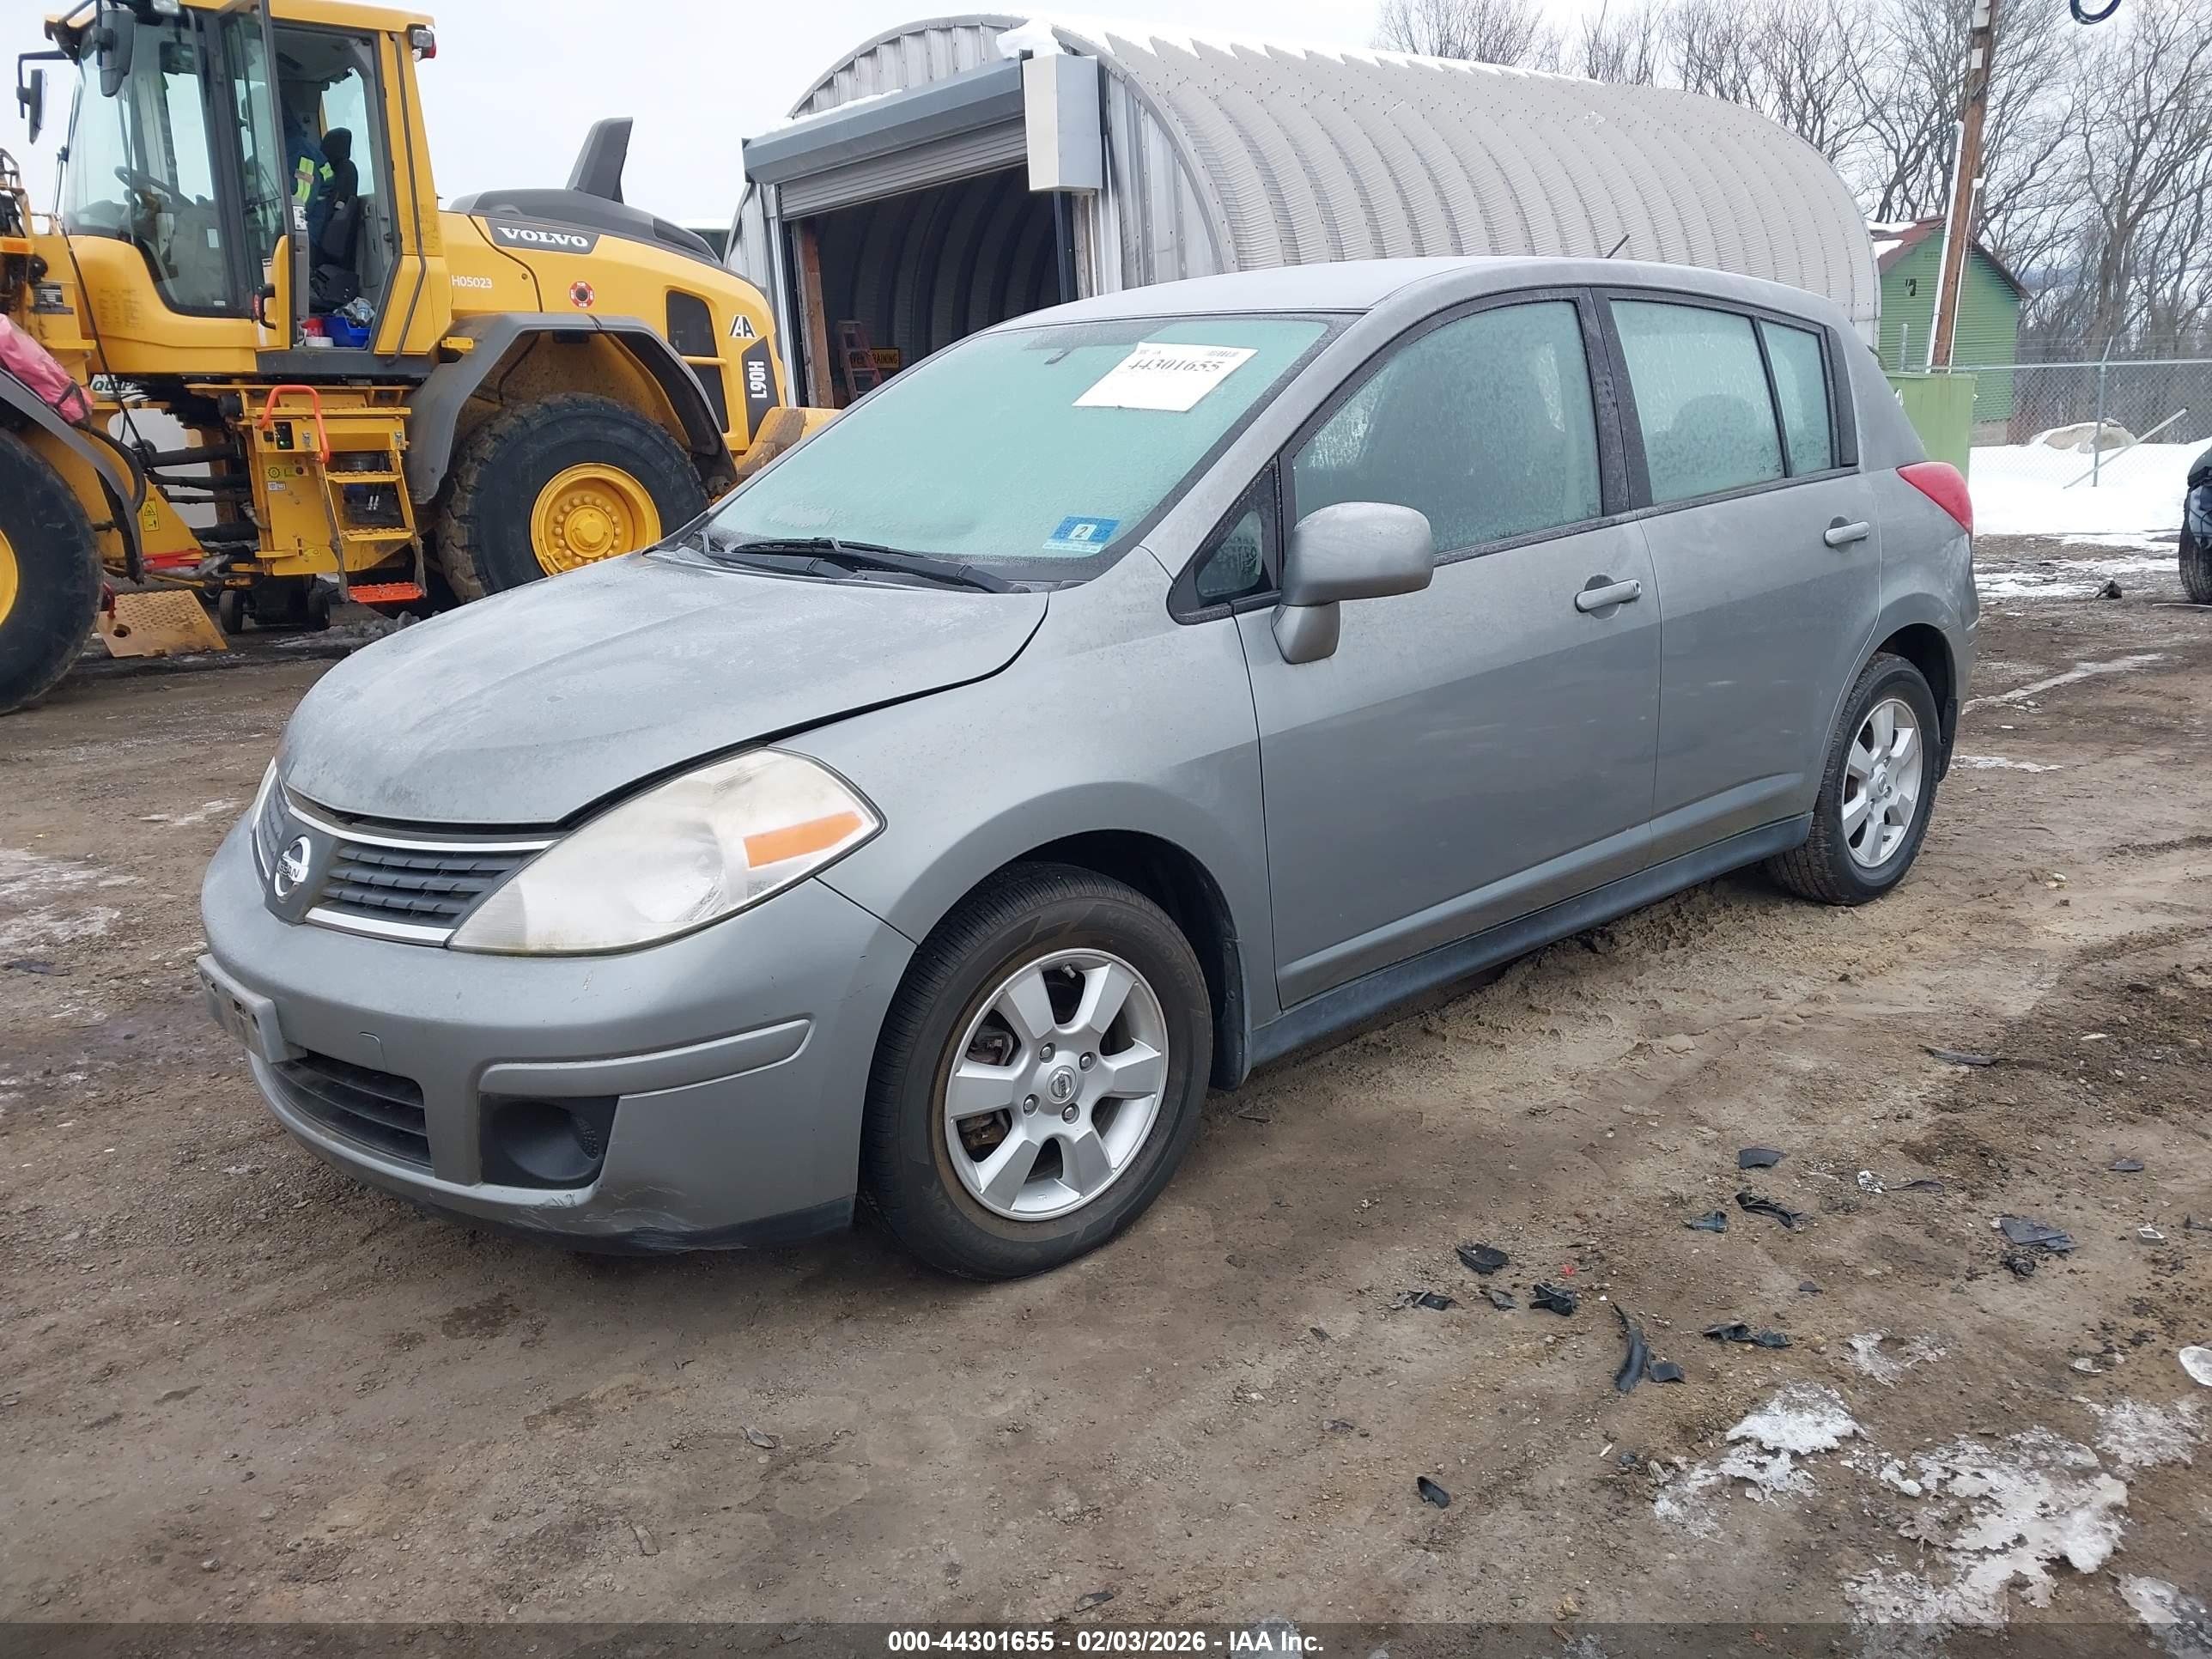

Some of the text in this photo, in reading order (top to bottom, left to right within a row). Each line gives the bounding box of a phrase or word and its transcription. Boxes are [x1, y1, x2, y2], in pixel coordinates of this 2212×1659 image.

[498, 227, 589, 247] VOLVO
[451, 275, 494, 289] H05023
[870, 352, 898, 365] RAINING
[1127, 359, 1225, 373] 44301655
[748, 361, 768, 398] L90H
